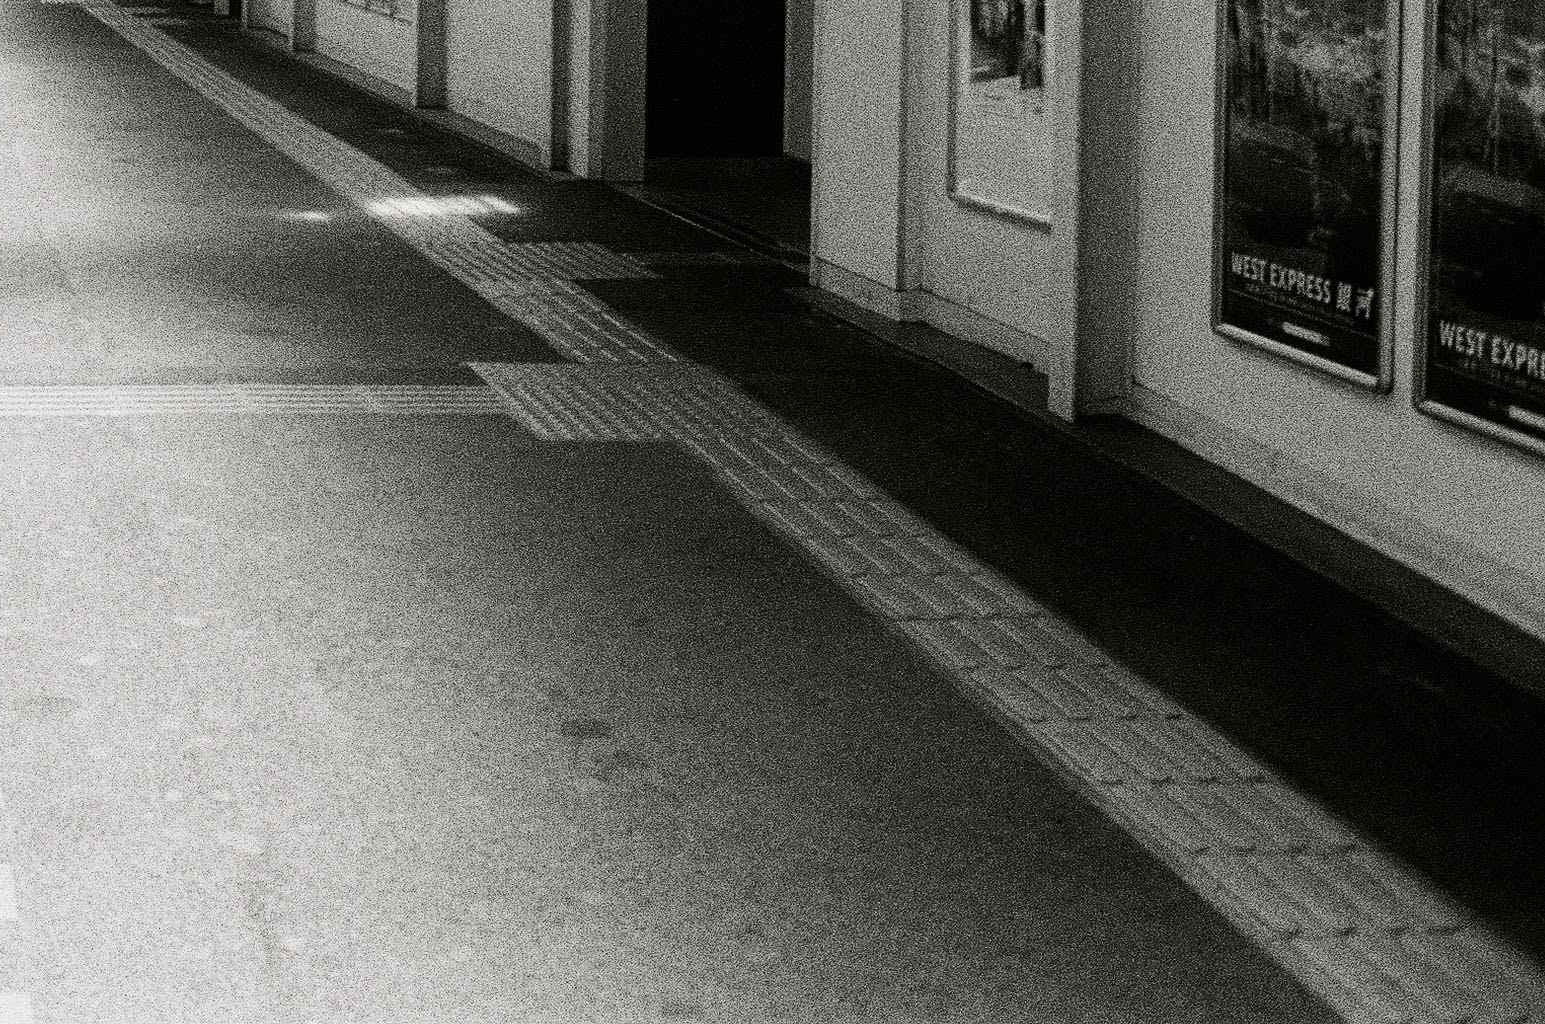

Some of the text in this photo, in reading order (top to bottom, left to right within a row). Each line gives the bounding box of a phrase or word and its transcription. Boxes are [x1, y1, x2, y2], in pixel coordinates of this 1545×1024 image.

[1231, 250, 1267, 283] WEST
[1269, 262, 1332, 305] EXPRESS
[1439, 319, 1487, 359] WEST
